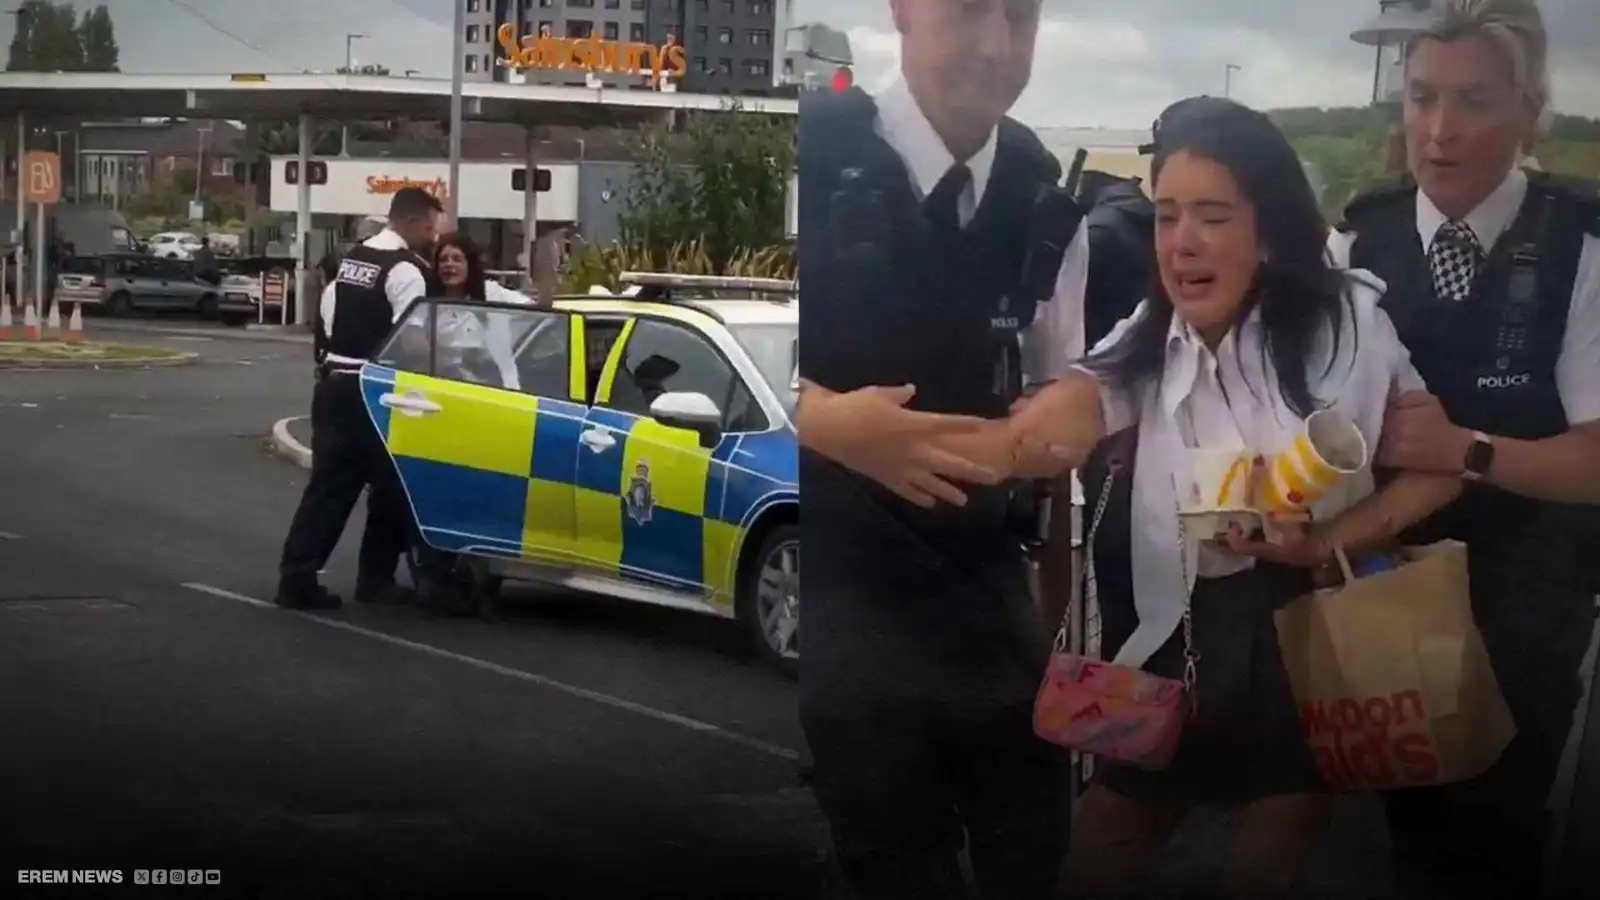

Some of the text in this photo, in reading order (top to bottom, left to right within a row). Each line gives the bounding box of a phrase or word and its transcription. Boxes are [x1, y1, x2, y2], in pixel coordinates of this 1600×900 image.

[497, 22, 686, 92] Sainsbury's
[339, 262, 376, 283] POLICE
[1477, 373, 1530, 388] POLICE
